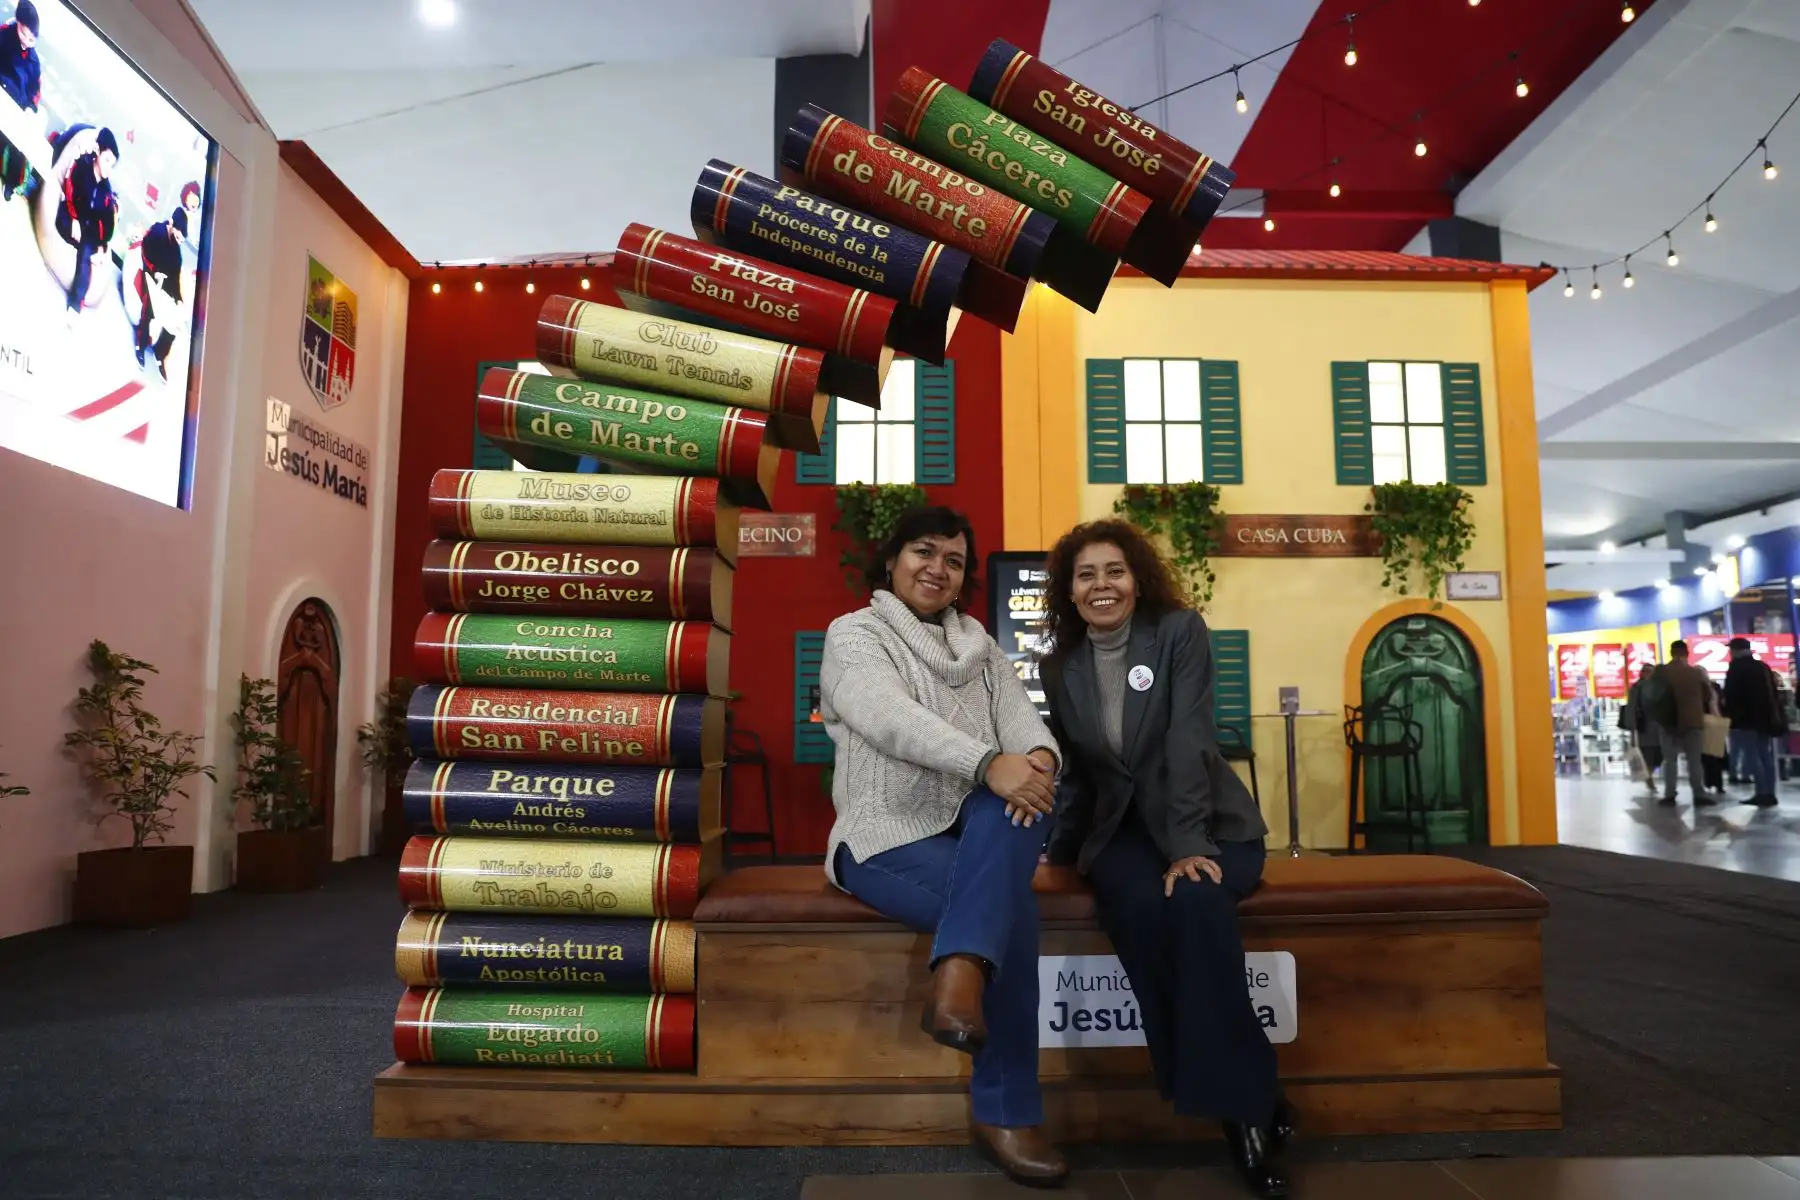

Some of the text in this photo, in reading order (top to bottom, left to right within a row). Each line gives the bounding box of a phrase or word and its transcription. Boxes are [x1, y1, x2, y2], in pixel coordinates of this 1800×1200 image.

[1064, 80, 1157, 141] Iglesia
[981, 109, 1069, 168] Plaza
[1033, 89, 1161, 176] San José
[866, 133, 986, 198] Campo
[946, 121, 1074, 210] Cáceres
[832, 149, 988, 239] de Marte
[773, 184, 891, 239] Parque
[758, 201, 889, 264] Próceres de la
[749, 220, 886, 285] Independencia
[709, 252, 798, 295] Plaza
[690, 273, 801, 323] San José
[638, 320, 719, 356] Club
[591, 339, 753, 391] Lawn Tennis
[555, 383, 687, 424] Campo
[271, 402, 368, 471] Municipalidad de
[530, 412, 700, 460] de Marte
[267, 432, 368, 509] Jesús María
[518, 477, 632, 501] Museo
[480, 505, 668, 526] de Historia Natural
[1237, 527, 1346, 544] CASA CUBA
[494, 550, 641, 577] Obelisco
[478, 579, 654, 603] Jorge Chávez
[516, 621, 614, 640] Concha
[504, 640, 619, 664] Acústica
[475, 664, 651, 683] del Campo de Marte
[468, 698, 641, 727] Residencial
[460, 726, 644, 759] San Felipe
[486, 770, 617, 802] Parque
[513, 801, 586, 818] Andrés
[469, 818, 634, 836] Avelino Cáceres
[479, 860, 613, 878] Ministerio de
[472, 881, 618, 911] Trabajo
[459, 936, 624, 961] Nunciatura
[479, 965, 607, 983] Apostólica
[507, 1004, 584, 1018] Hospital
[1049, 1000, 1147, 1032] Jesú
[487, 1022, 600, 1048] Edgardo
[476, 1048, 615, 1065] Rebagliati
